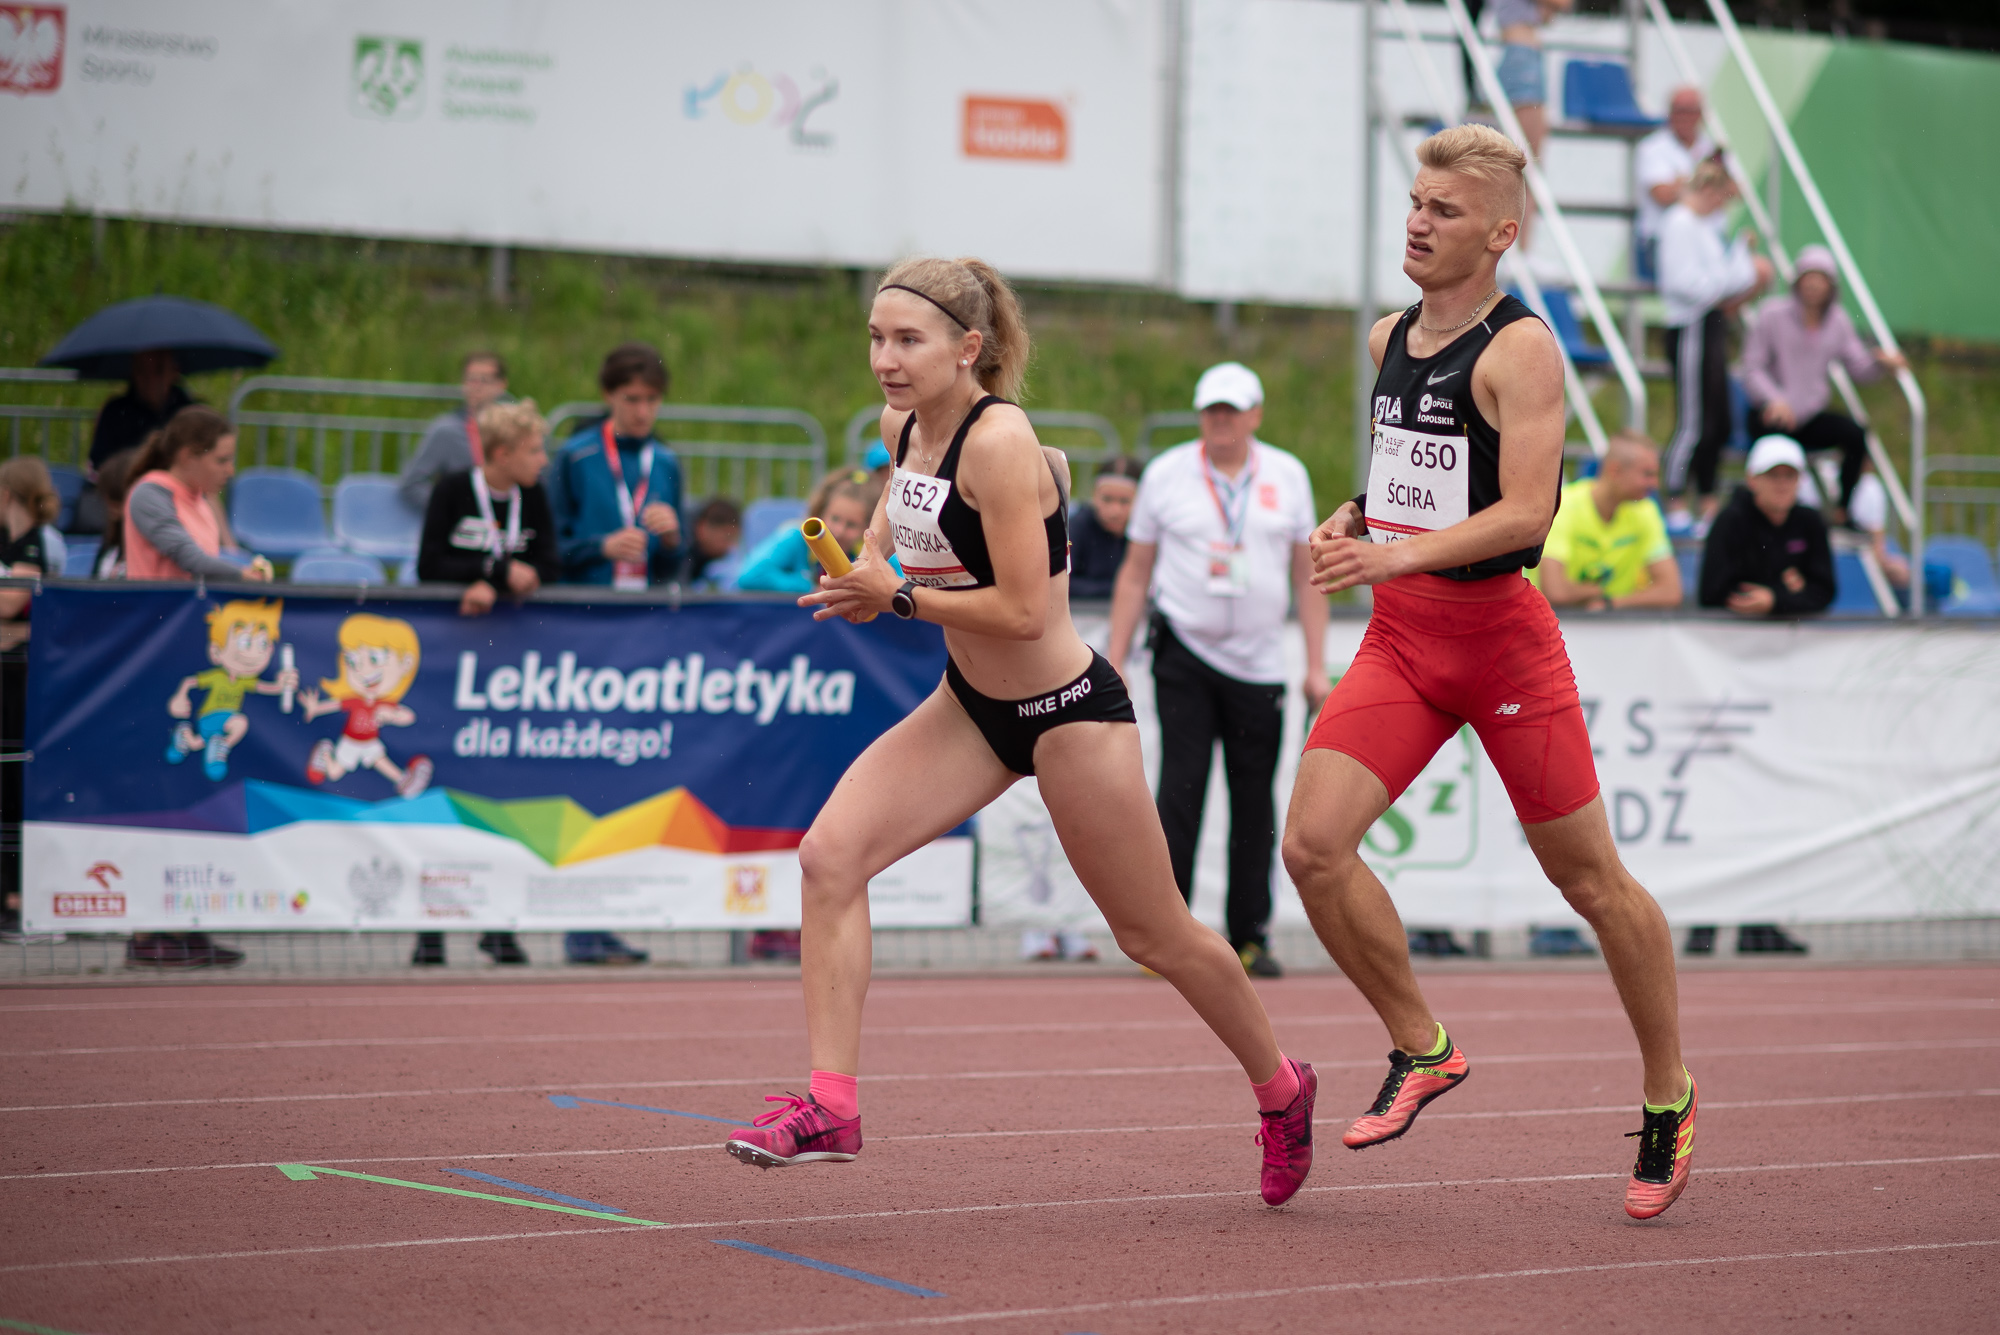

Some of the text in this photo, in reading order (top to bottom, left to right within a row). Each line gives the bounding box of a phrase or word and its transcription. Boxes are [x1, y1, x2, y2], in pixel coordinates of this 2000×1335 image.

[1432, 400, 1453, 409] OPOLE
[1411, 440, 1456, 471] 650
[902, 480, 938, 512] 652
[1387, 477, 1436, 511] ŚCIRA
[920, 576, 948, 587] 2021
[456, 651, 856, 725] Lekkoatletyka
[1018, 677, 1091, 717] NIKE PRO
[455, 718, 674, 766] dla każdego!
[1424, 1067, 1449, 1079] RACING
